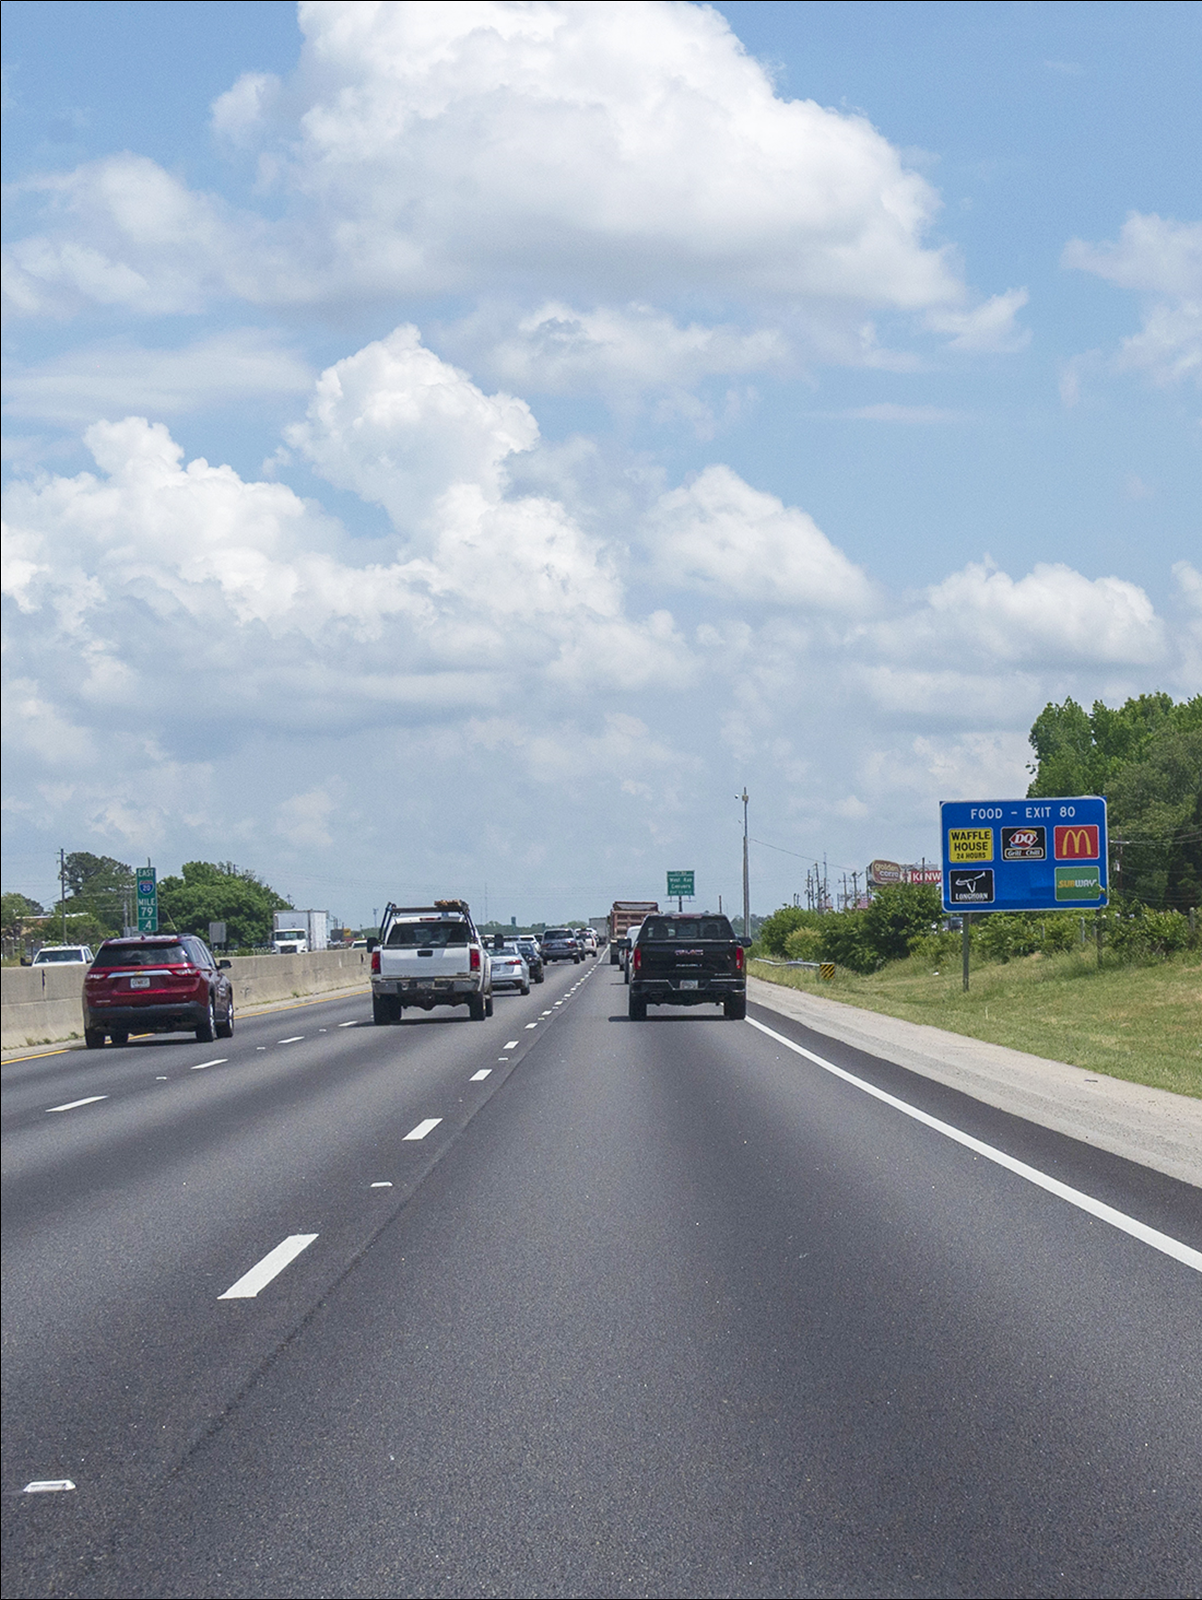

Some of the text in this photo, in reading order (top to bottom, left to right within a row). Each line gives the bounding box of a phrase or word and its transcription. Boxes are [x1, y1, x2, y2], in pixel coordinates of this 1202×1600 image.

[971, 808, 1003, 820] FOOD
[1025, 806, 1052, 818] EXIT
[1059, 806, 1076, 818] 80
[951, 831, 991, 841] WAFFLE
[1014, 833, 1034, 844] DQ
[954, 842, 989, 851] HOUSE
[138, 869, 154, 877] EAST
[1058, 879, 1097, 889] SUBWAY
[141, 907, 153, 917] 79
